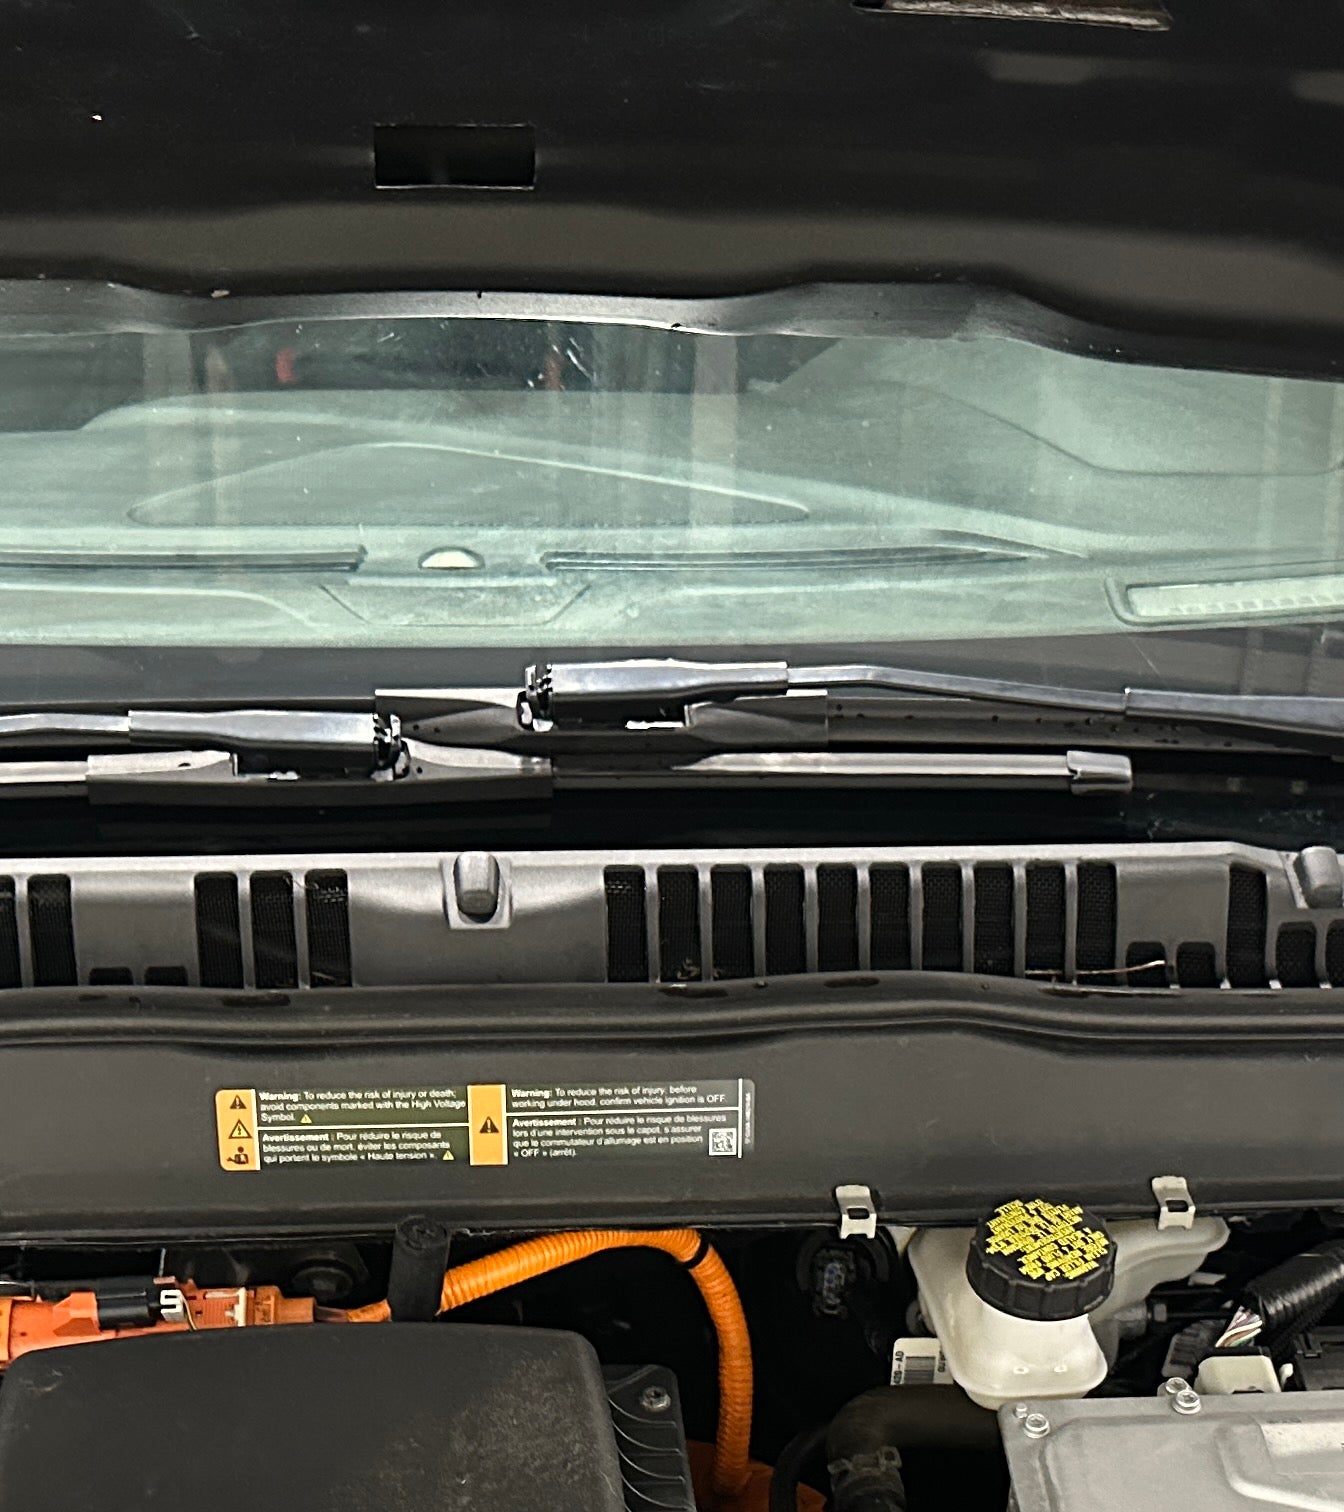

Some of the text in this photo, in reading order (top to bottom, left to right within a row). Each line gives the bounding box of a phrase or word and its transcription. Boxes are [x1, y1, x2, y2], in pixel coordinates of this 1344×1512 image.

[304, 1092, 314, 1100] To
[316, 1091, 346, 1100] reduce
[348, 1091, 362, 1099] the
[364, 1090, 379, 1099] risk
[382, 1090, 391, 1099] of
[393, 1090, 416, 1101] injury
[555, 1088, 565, 1097] To
[567, 1088, 596, 1097] reduce
[598, 1087, 612, 1096] the
[614, 1086, 629, 1096] risk
[631, 1086, 641, 1095] of
[669, 1085, 697, 1094] before
[260, 1099, 466, 1113] avoid components marked with the High Voltage
[512, 1099, 545, 1110] working
[547, 1098, 571, 1107] under
[599, 1096, 631, 1106] confirm
[633, 1096, 663, 1105] vehicle
[665, 1095, 696, 1106] ignition
[697, 1095, 705, 1104] is
[520, 1148, 540, 1158] OFF
